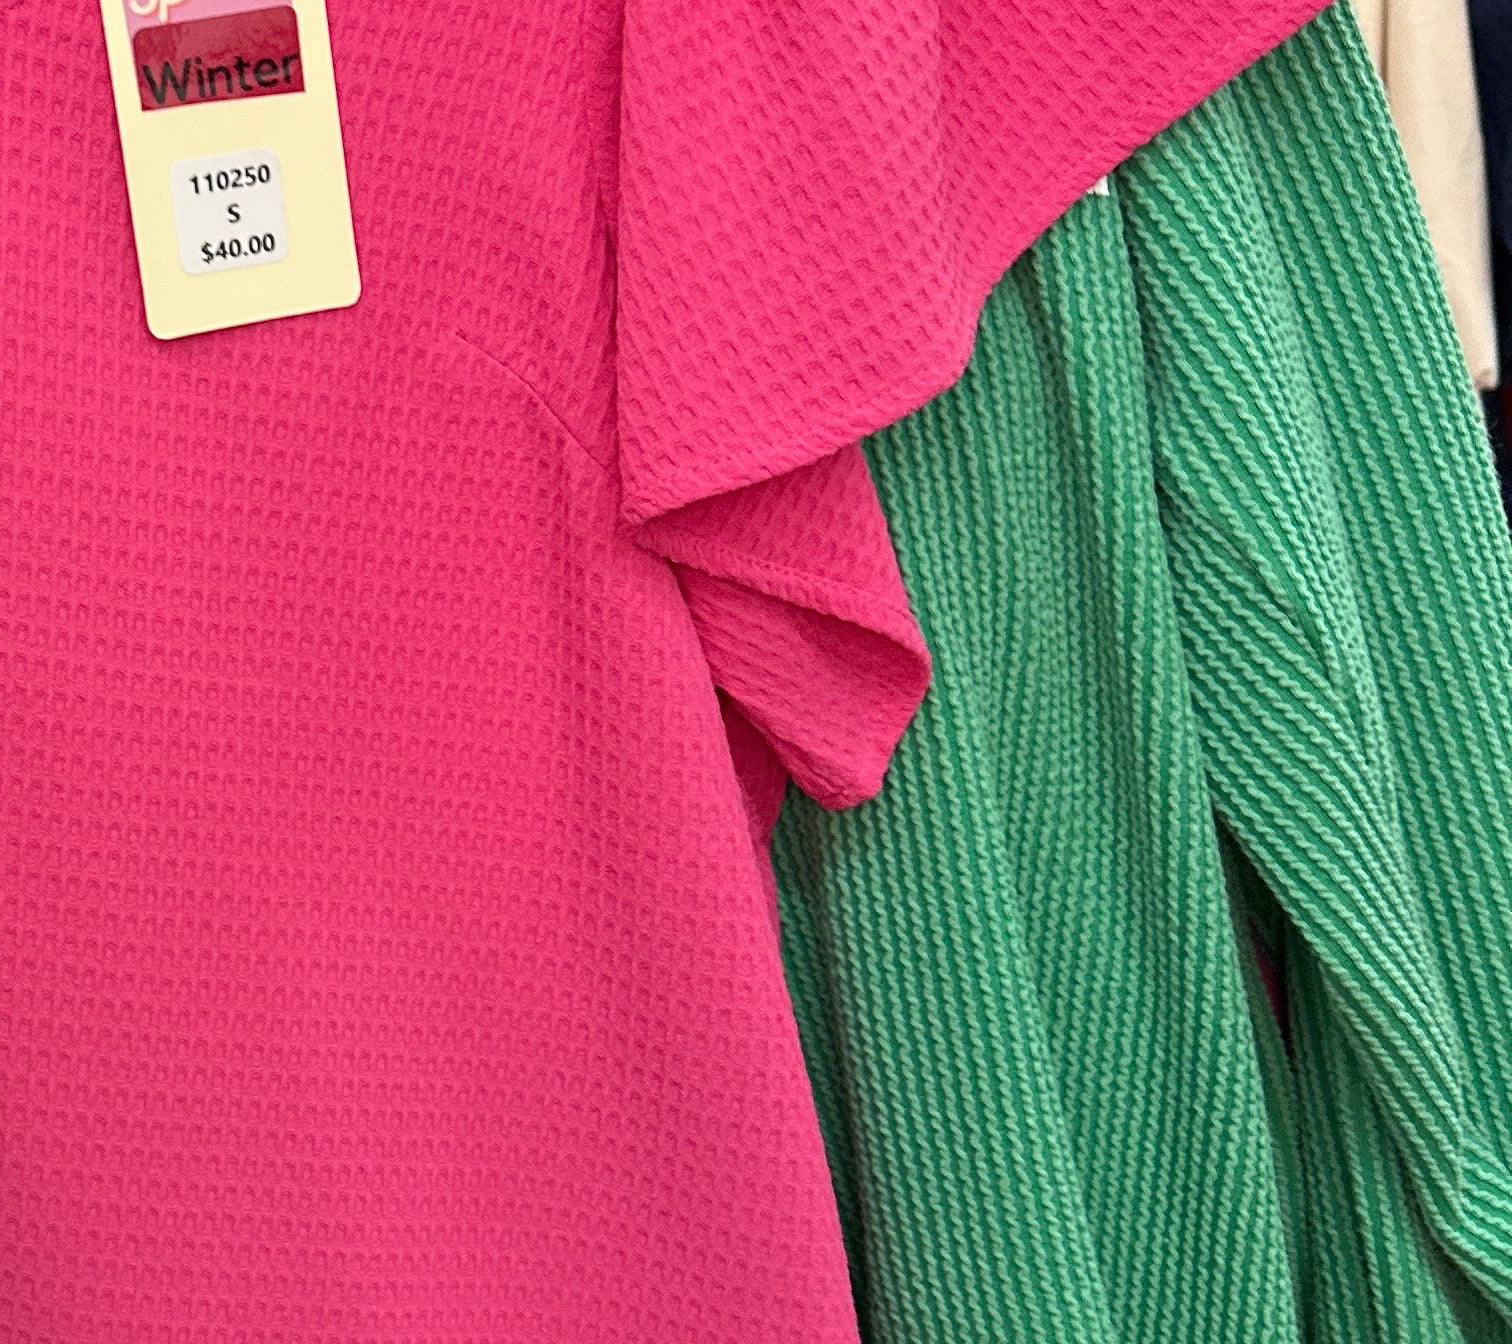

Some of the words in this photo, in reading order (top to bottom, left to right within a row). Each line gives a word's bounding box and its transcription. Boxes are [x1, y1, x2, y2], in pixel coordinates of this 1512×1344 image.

[142, 54, 301, 105] Winter
[189, 163, 271, 194] 110250
[227, 203, 242, 223] S
[201, 232, 276, 264] $40.00
